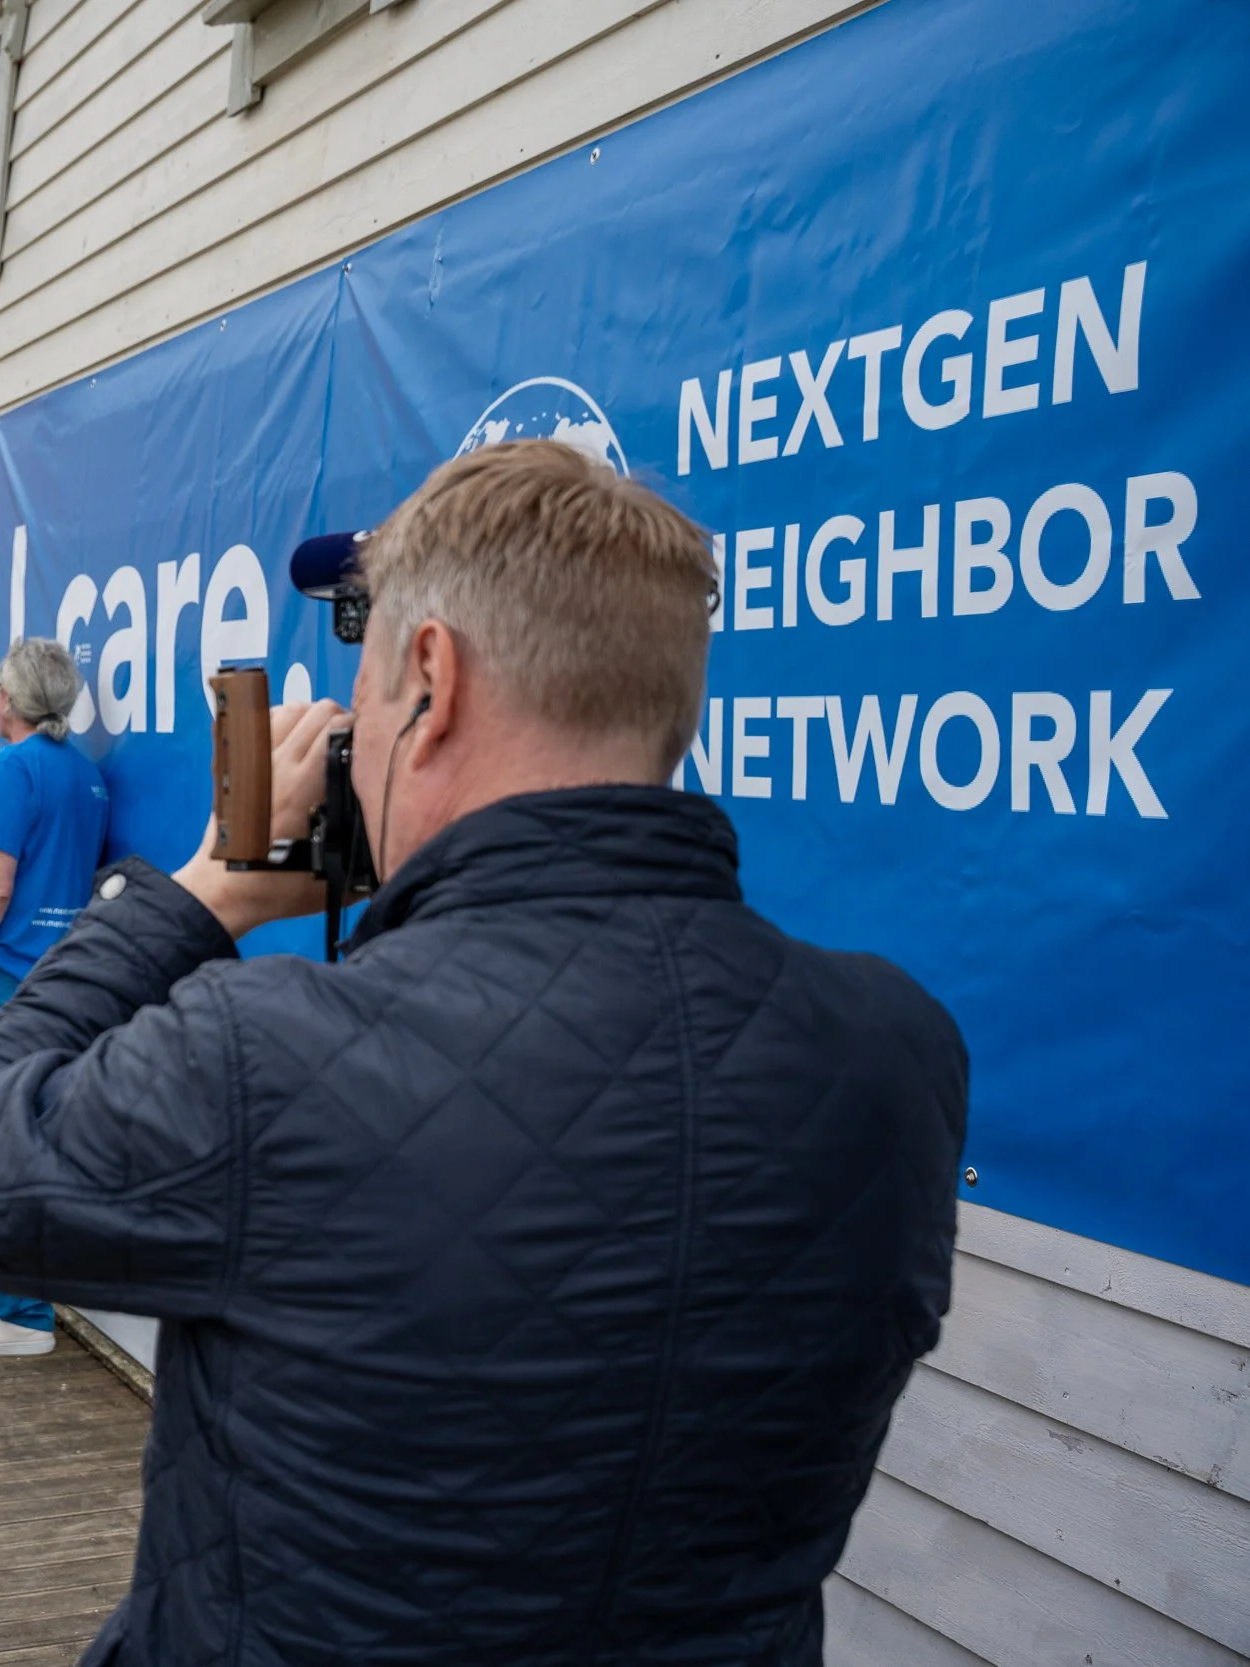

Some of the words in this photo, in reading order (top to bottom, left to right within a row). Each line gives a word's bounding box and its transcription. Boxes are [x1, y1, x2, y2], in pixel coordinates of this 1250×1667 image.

[677, 261, 1148, 476] NEXTGEN
[711, 471, 1201, 632] EIGHBOR
[672, 688, 1173, 819] NETWORK
